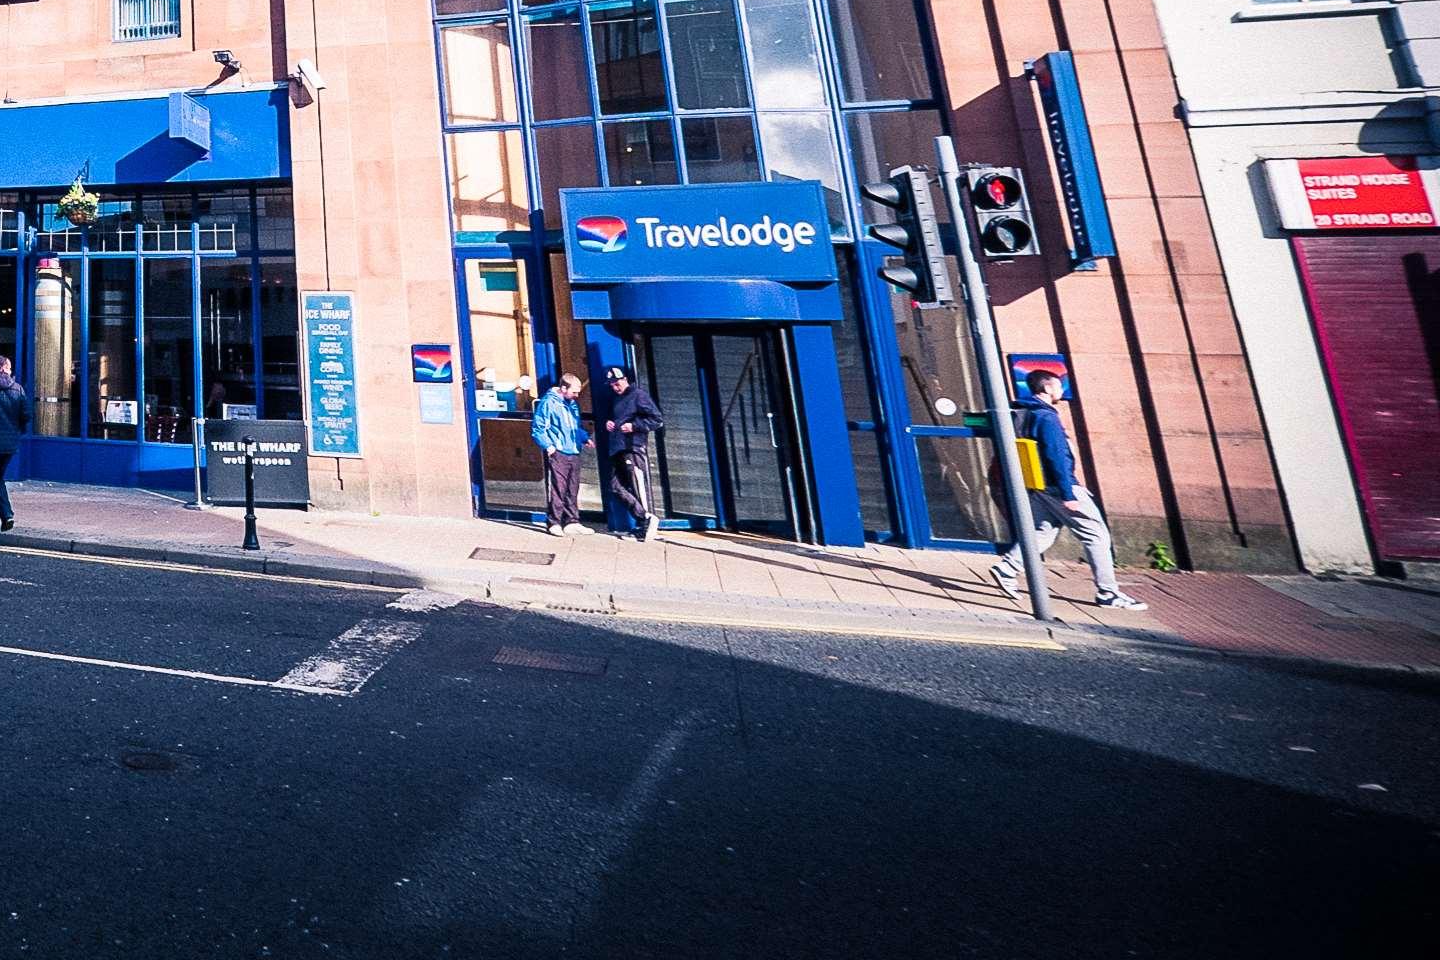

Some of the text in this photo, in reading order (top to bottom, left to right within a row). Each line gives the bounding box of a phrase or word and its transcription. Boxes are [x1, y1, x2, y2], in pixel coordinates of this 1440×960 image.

[1303, 174, 1410, 187] STRAND HOUSE
[1307, 188, 1358, 200] SUITES
[1332, 213, 1390, 225] STRAND
[1391, 212, 1433, 224] ROAD
[635, 215, 816, 253] Travelodge
[320, 309, 351, 320] WHARF
[318, 323, 341, 331] FOOD
[211, 442, 301, 453] THE IE WHARF
[222, 456, 292, 466] wetrspoon
